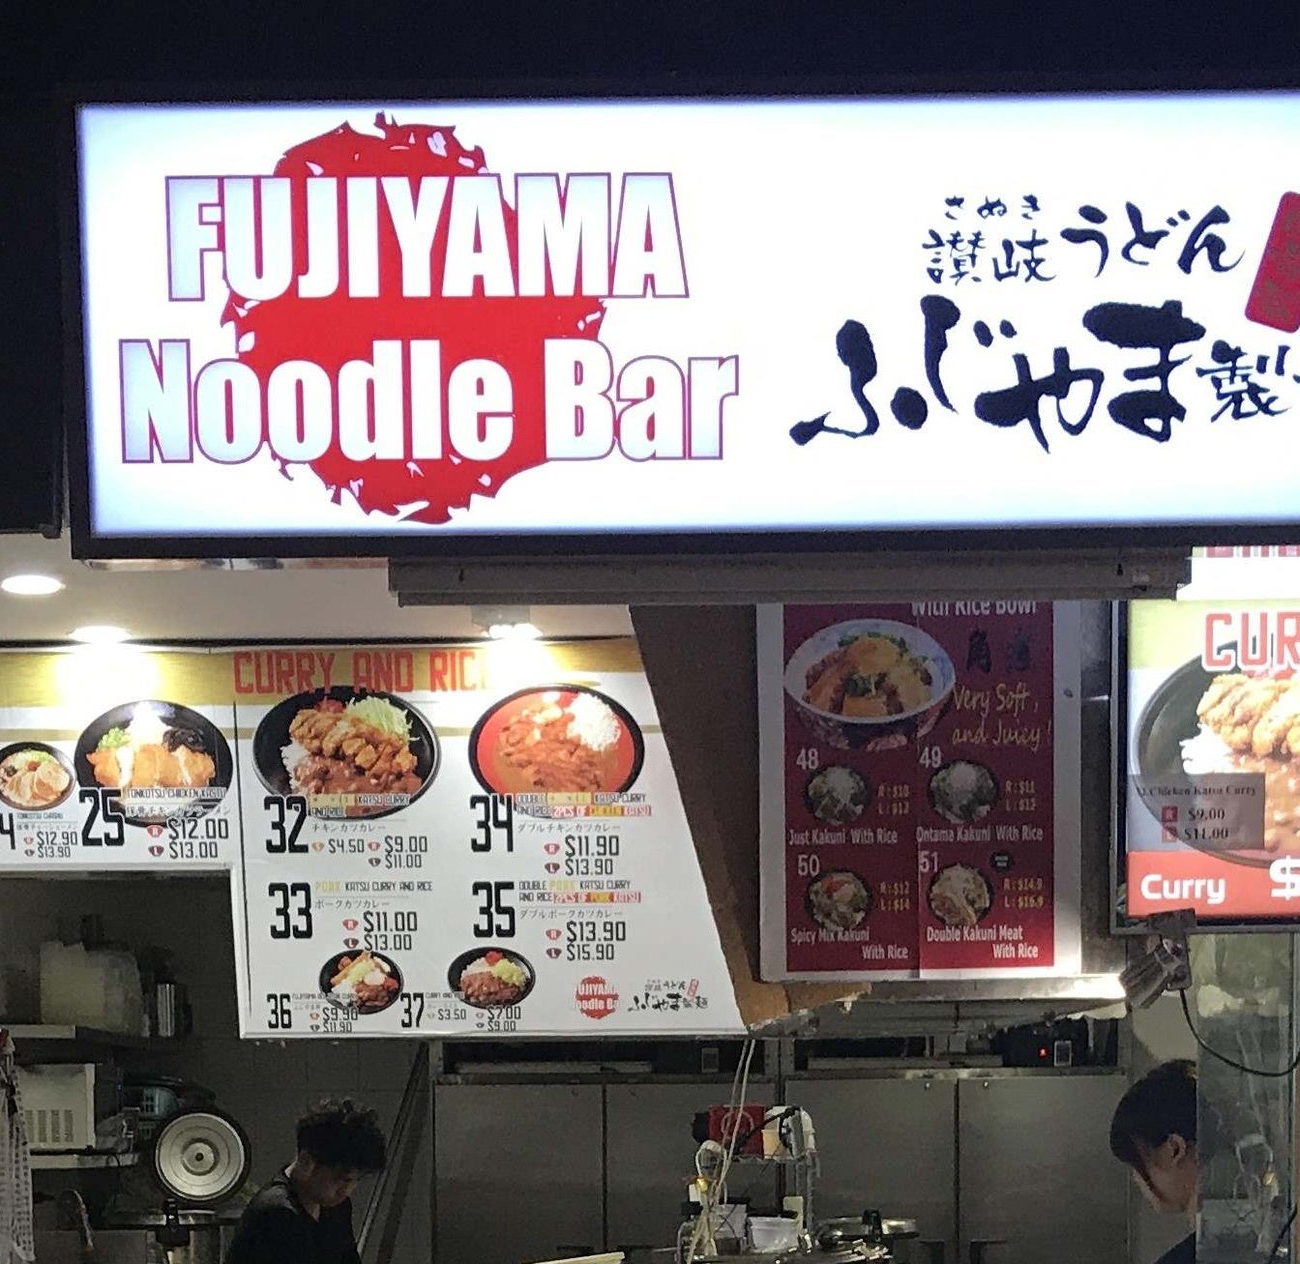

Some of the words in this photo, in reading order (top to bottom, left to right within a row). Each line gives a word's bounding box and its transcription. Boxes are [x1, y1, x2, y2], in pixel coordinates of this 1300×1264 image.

[944, 195, 1040, 220] さぬき
[164, 171, 690, 302] FUJIYAMA
[120, 337, 517, 464] Noodle
[544, 342, 739, 462] Bar
[234, 651, 335, 694] CURRY
[353, 651, 414, 693] AND
[953, 685, 990, 717] Very
[952, 717, 988, 744] and
[920, 747, 942, 768] 49
[79, 789, 125, 847] 25
[168, 818, 229, 841] $12.00
[264, 796, 309, 853] 32
[470, 795, 514, 852] 34
[328, 838, 365, 854] $4.50
[384, 835, 428, 853] $9.00
[789, 830, 809, 845] Just
[812, 829, 846, 844] Kakuni
[851, 828, 874, 843] With
[877, 829, 898, 843] Rice
[957, 826, 991, 841] Kakuni
[996, 826, 1019, 840] With
[1022, 826, 1043, 840] Rice
[169, 840, 218, 860] $13.00
[565, 834, 620, 857] $11.90
[385, 853, 422, 869] $11.00
[565, 858, 614, 876] $13.90
[919, 851, 939, 872] 51
[1140, 874, 1226, 905] Curry
[268, 882, 313, 939] 33
[472, 881, 516, 938] 35
[363, 911, 417, 932] $11.00
[566, 920, 626, 943] $13.90
[927, 926, 960, 941] Double
[963, 925, 996, 941] Kakuni
[999, 925, 1023, 941] Meat
[364, 933, 412, 951] $13.00
[566, 944, 615, 962] $15.90
[862, 945, 885, 959] With
[888, 945, 908, 959] Rice
[993, 943, 1015, 958] With
[1018, 943, 1038, 958] Rice
[267, 993, 292, 1030] 36
[400, 992, 424, 1029] 37
